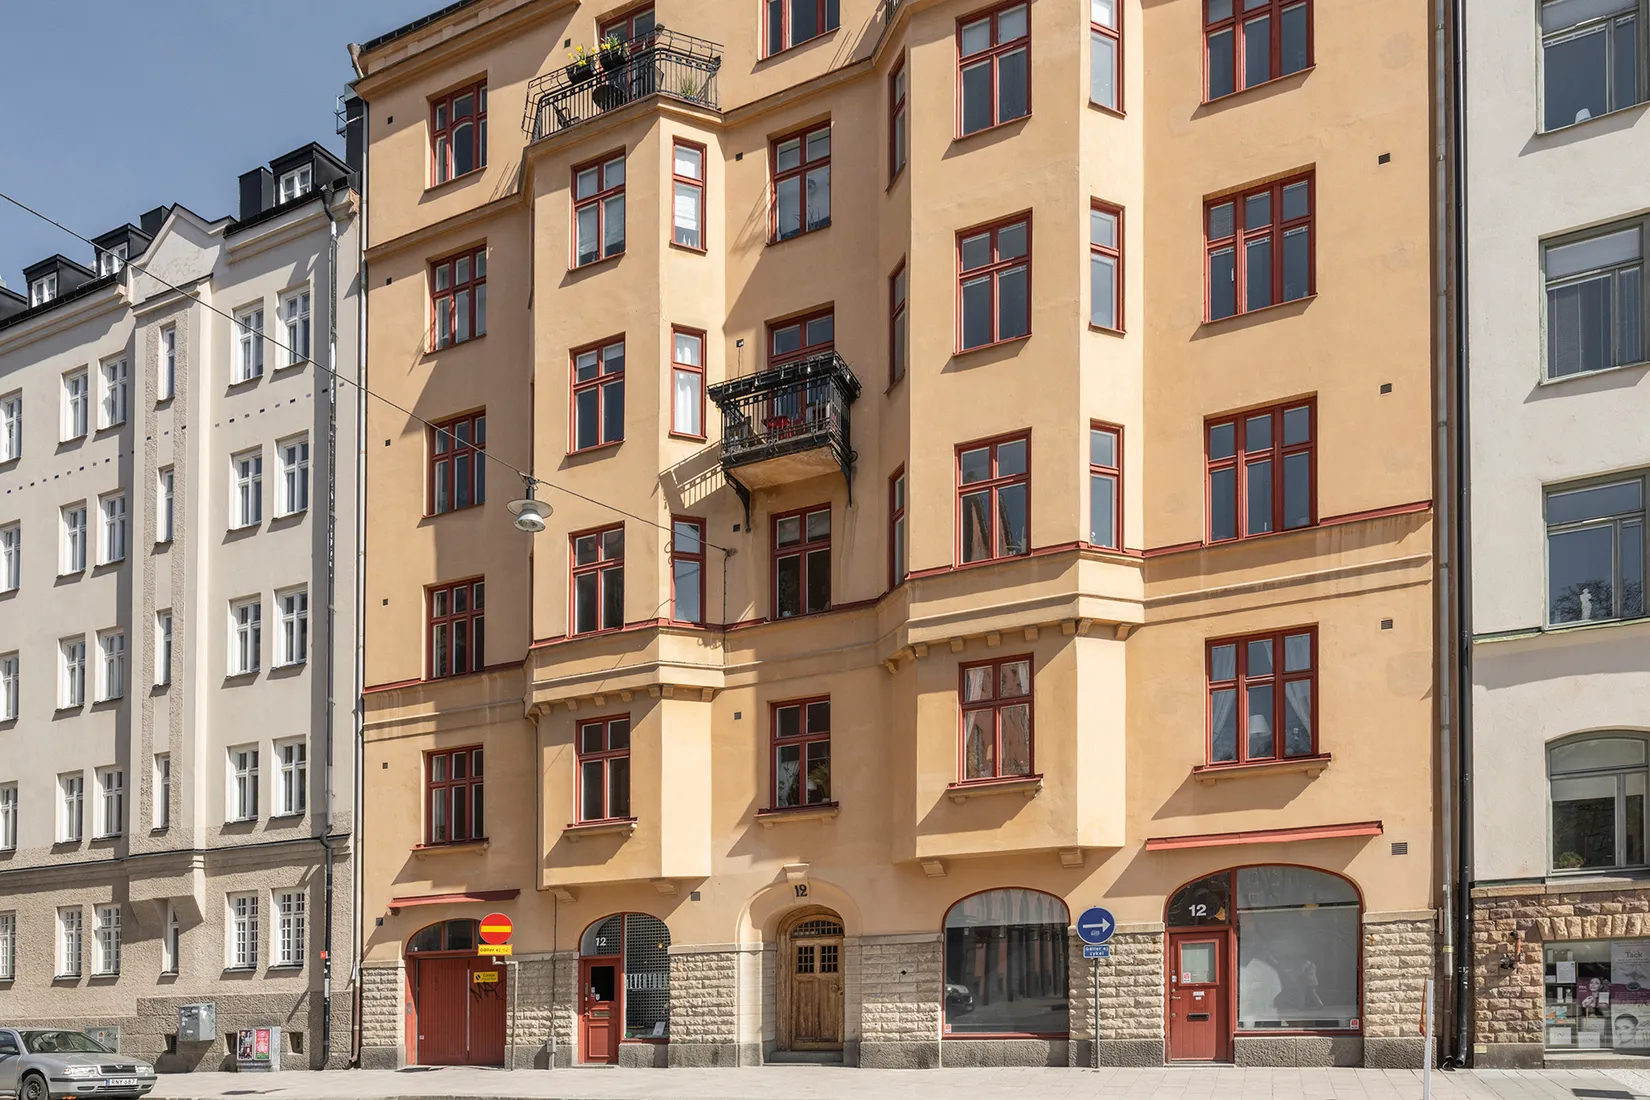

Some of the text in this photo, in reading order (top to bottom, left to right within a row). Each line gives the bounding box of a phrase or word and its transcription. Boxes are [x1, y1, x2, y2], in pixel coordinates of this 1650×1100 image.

[795, 884, 808, 897] 12
[1188, 904, 1207, 917] 12
[595, 937, 607, 946] 12
